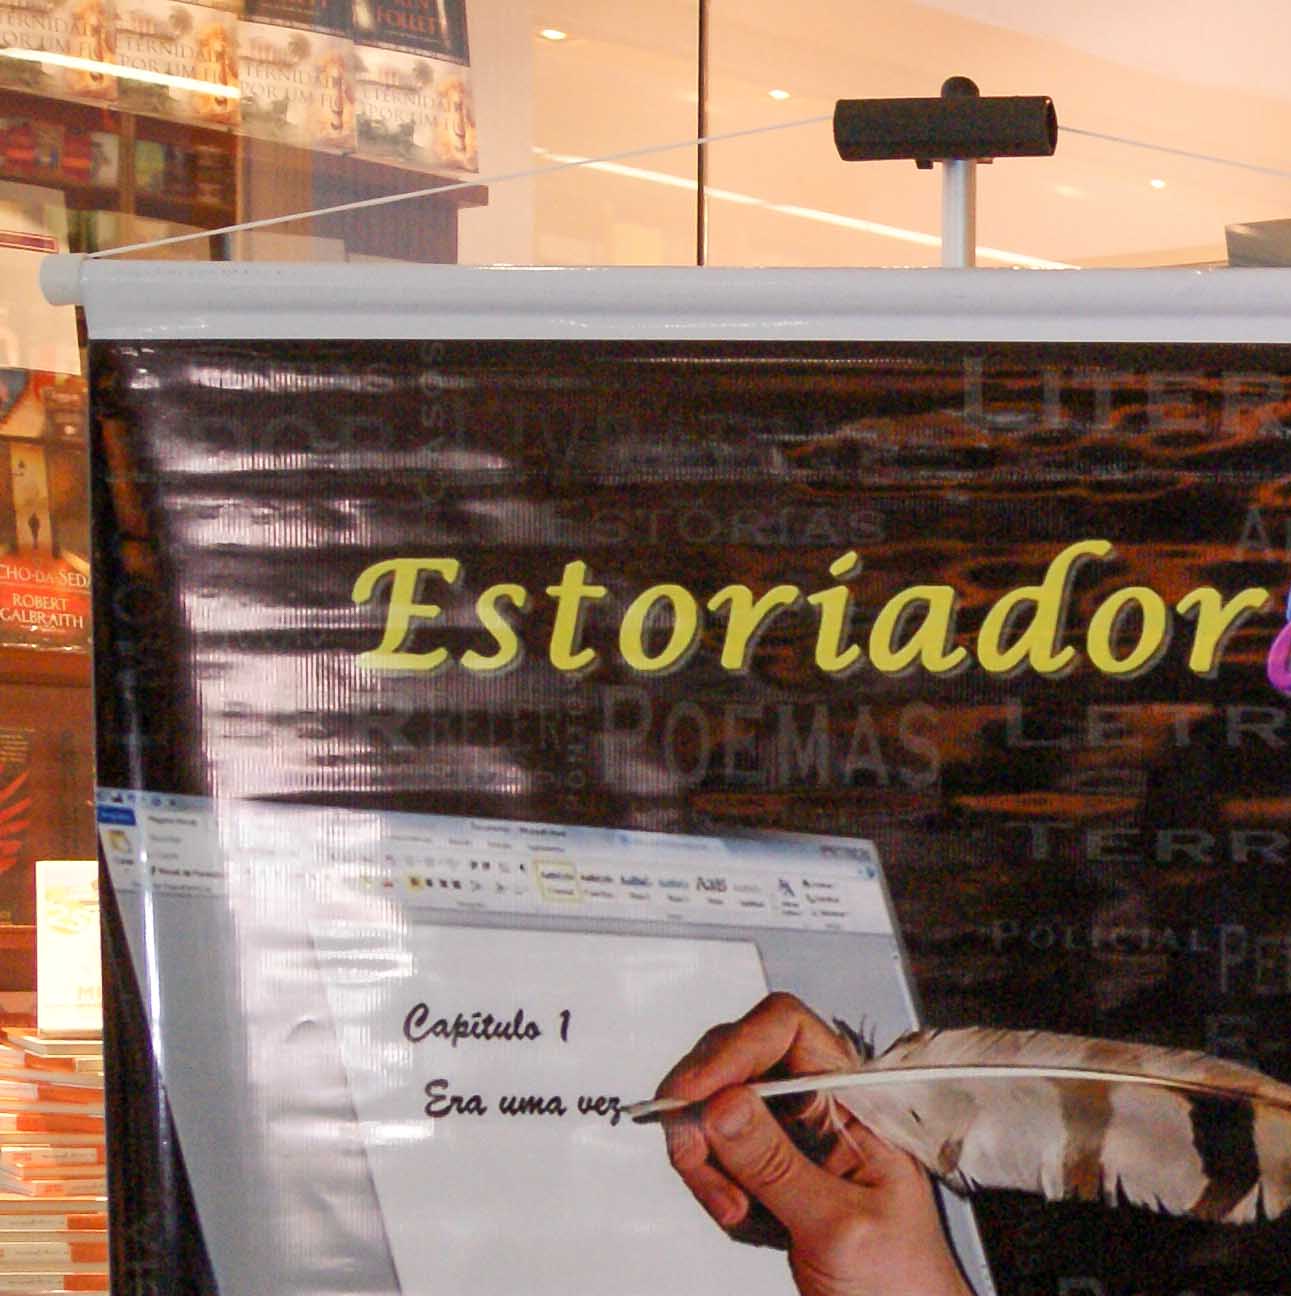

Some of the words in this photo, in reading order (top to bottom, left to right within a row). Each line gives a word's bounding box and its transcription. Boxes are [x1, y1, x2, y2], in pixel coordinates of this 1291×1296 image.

[12, 591, 69, 612] ROBERT
[603, 685, 942, 789] POEMAS
[403, 1001, 541, 1044] Capítulo
[558, 1008, 573, 1044] 1
[423, 1079, 487, 1120] Era
[500, 1092, 568, 1119] uma
[577, 1092, 629, 1128] vez
